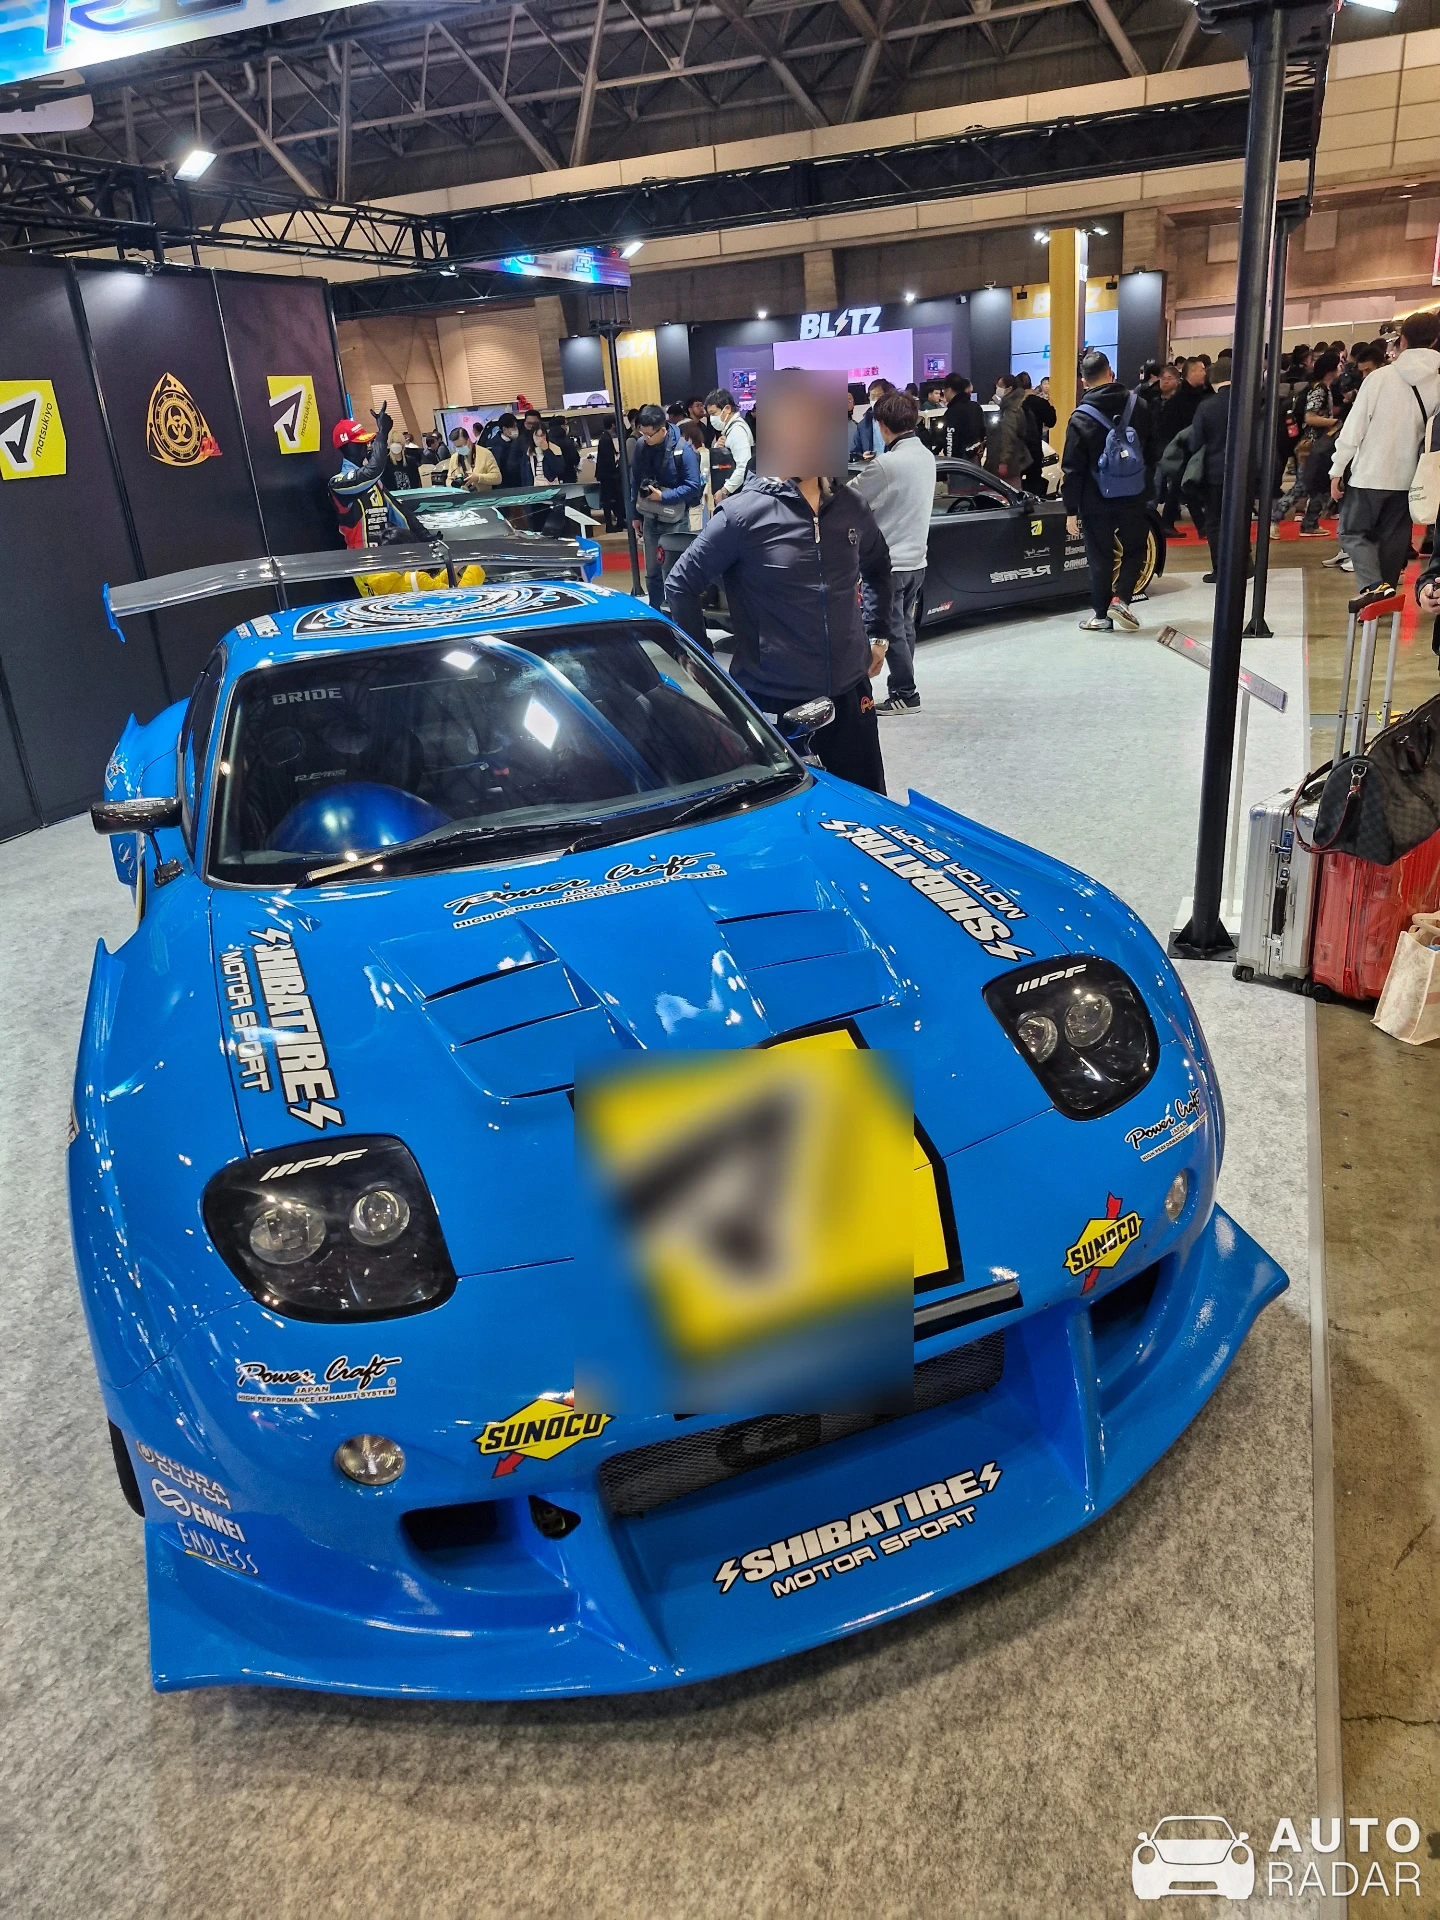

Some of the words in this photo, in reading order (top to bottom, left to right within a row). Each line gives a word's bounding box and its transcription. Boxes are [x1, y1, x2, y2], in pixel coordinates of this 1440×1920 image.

[800, 306, 882, 340] BLITZ
[35, 403, 53, 458] matsukiyo
[300, 394, 313, 437] matsukiyo
[271, 688, 342, 705] BRIDE
[878, 824, 951, 863] SPORT
[445, 878, 590, 914] Power
[605, 853, 715, 882] Craft
[455, 914, 493, 928] HIGH
[497, 891, 603, 918] PERFORMANCE
[605, 878, 668, 896] EXHAUST
[671, 870, 726, 882] SYSTEM
[563, 883, 619, 897] JAPAN
[943, 862, 1028, 919] MOTOR
[220, 950, 253, 1010] MOTOR
[253, 943, 337, 1104] SHIBATIRE
[231, 1011, 271, 1091] SPORT
[1125, 1115, 1175, 1149] Power
[1175, 1088, 1200, 1117] Craft
[1155, 1132, 1187, 1154] PERFORMANCE
[1170, 1121, 1187, 1136] JAPAN
[1071, 1215, 1139, 1271] SUNOCO
[237, 1362, 315, 1387] Power
[326, 1354, 401, 1390] Craft
[237, 1394, 256, 1402] HIGH
[257, 1395, 315, 1404] PERFORMANCE
[318, 1393, 358, 1402] EXHAUST
[360, 1388, 396, 1398] SYSTEM
[295, 1386, 329, 1395] JAPAN
[485, 1413, 602, 1450] SUNOCO
[158, 1461, 231, 1510] CLUTCH
[190, 1501, 246, 1543] ENKEI
[741, 1470, 984, 1582] SHIBATIRE
[177, 1521, 259, 1574] ENDLESS
[772, 1546, 876, 1597] MOTOR
[879, 1506, 976, 1554] SPORT
